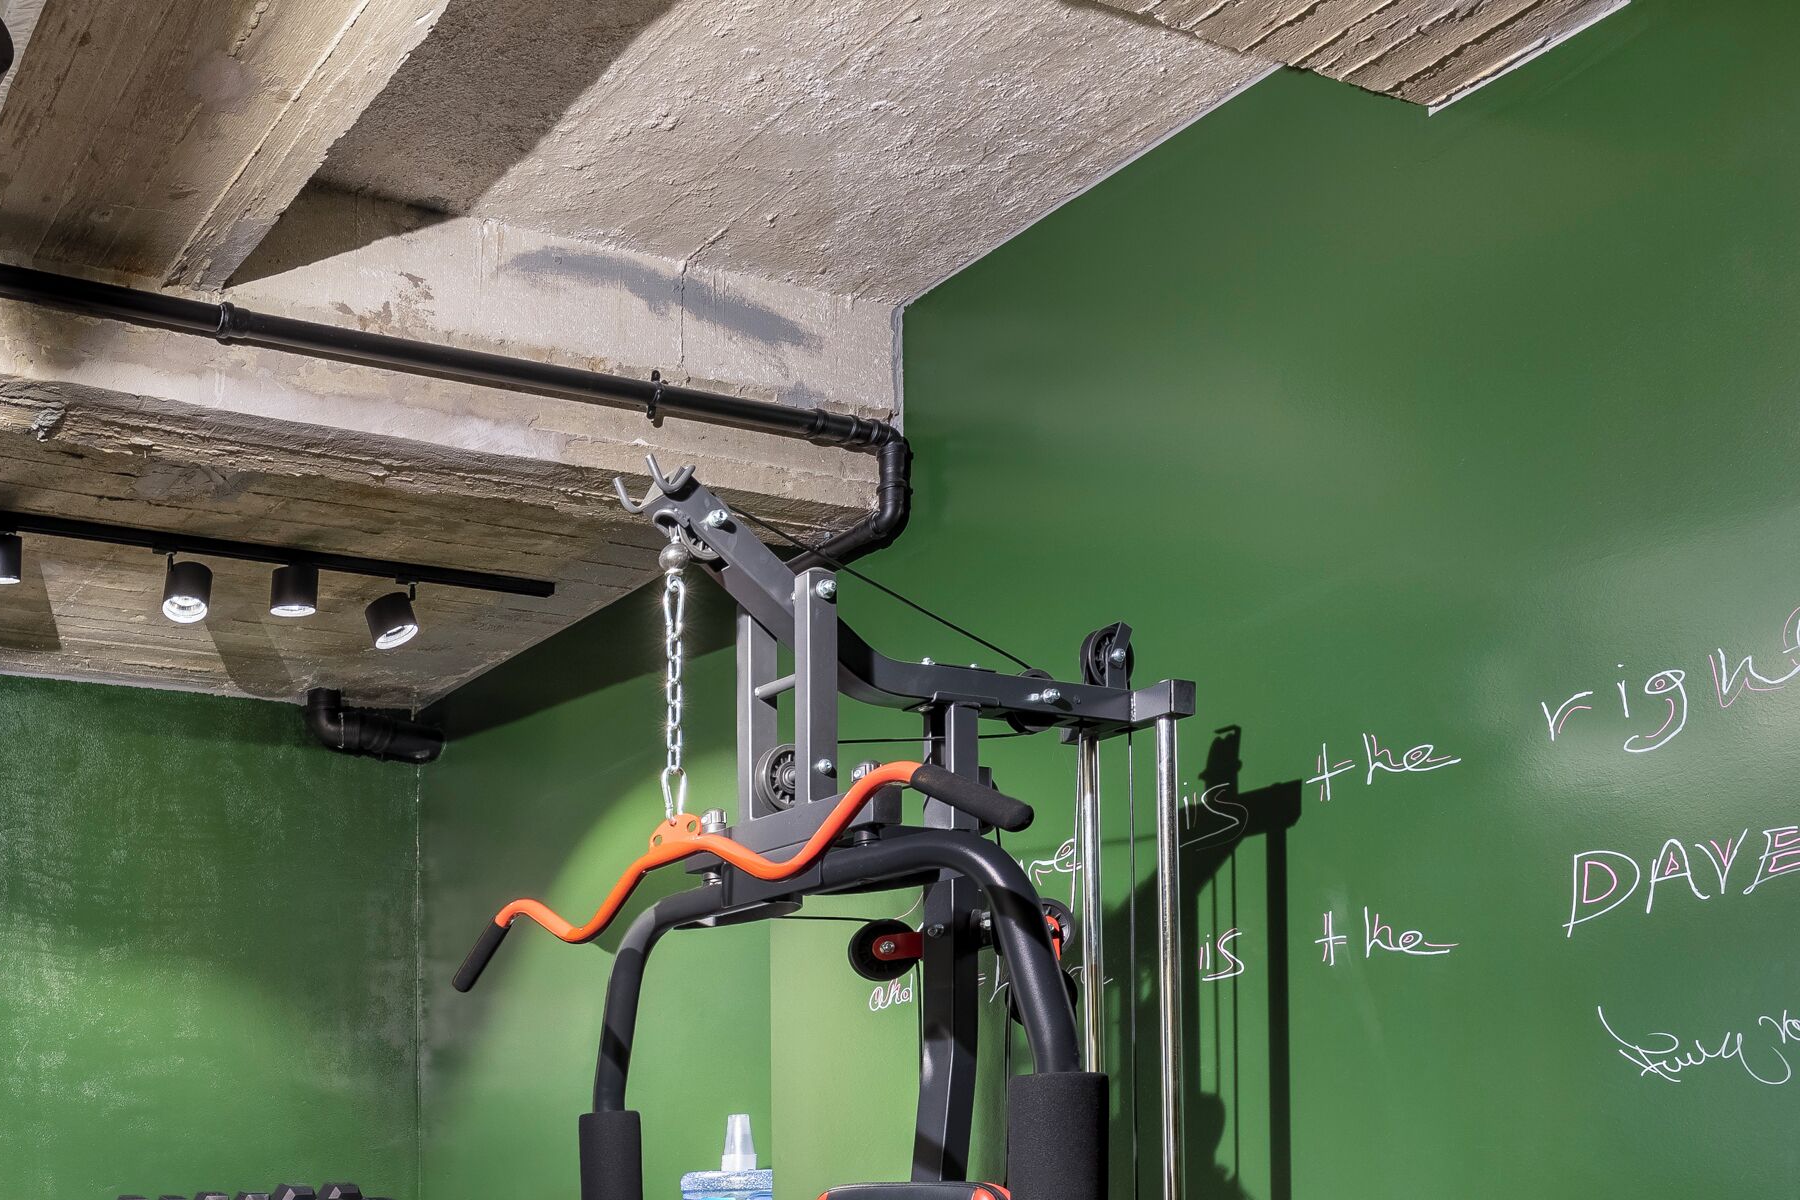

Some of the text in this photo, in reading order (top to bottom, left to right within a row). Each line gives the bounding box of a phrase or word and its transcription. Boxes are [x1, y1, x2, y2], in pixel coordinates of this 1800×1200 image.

[1305, 732, 1462, 802] the
[1198, 926, 1245, 982] is
[1314, 905, 1461, 967] the
